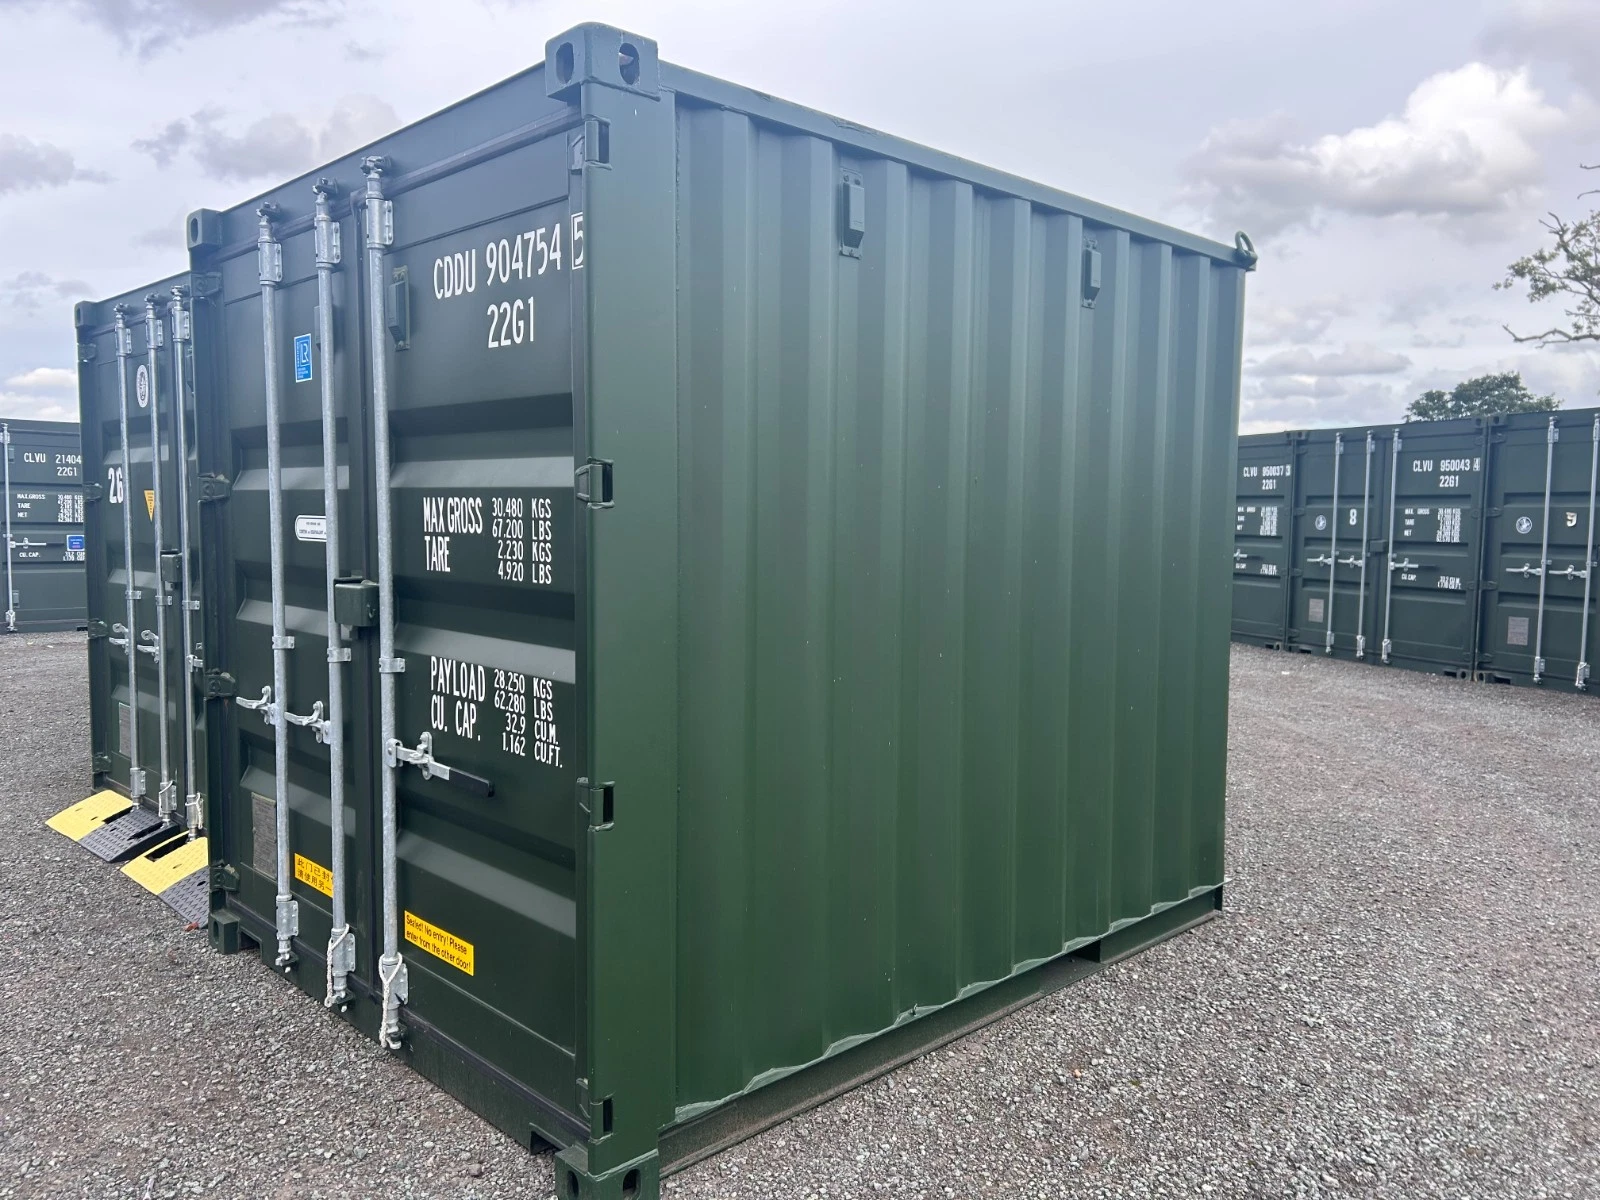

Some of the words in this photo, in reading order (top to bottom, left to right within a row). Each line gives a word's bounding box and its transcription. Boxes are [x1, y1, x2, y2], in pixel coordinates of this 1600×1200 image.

[433, 249, 476, 300] CDDU
[486, 223, 562, 286] 904754
[573, 215, 584, 266] 5
[487, 296, 534, 348] 22G1
[24, 452, 46, 462] CLVU
[1412, 460, 1433, 472] CLVU
[1440, 458, 1470, 472] 950043
[56, 466, 78, 476] 22G1
[1243, 466, 1258, 478] CLVU
[1439, 475, 1459, 487] 22G1
[108, 467, 124, 504] 26
[423, 496, 445, 532] MAX
[447, 497, 483, 534] GROSS
[532, 498, 552, 518] KGS
[1350, 508, 1357, 526] 8
[532, 520, 552, 540] LBS
[424, 536, 450, 572] TARE
[532, 541, 552, 562] KGS
[532, 562, 552, 584] LBS
[430, 656, 486, 702] PAYLOAD
[533, 677, 552, 700] KGS
[431, 694, 448, 732] CU.
[455, 700, 481, 742] CAP.
[534, 698, 554, 722] LBS
[506, 712, 526, 734] 32.9
[534, 720, 558, 745] CU.M.
[534, 741, 562, 768] CU.FT.
[297, 858, 334, 882] 此门已封
[406, 914, 424, 932] Sealed!
[424, 924, 432, 937] No
[432, 931, 448, 946] entry!
[450, 938, 467, 955] Please
[406, 930, 418, 942] enter
[419, 935, 430, 950] from
[432, 943, 440, 954] the
[441, 950, 455, 962] other
[456, 957, 470, 972] door!
